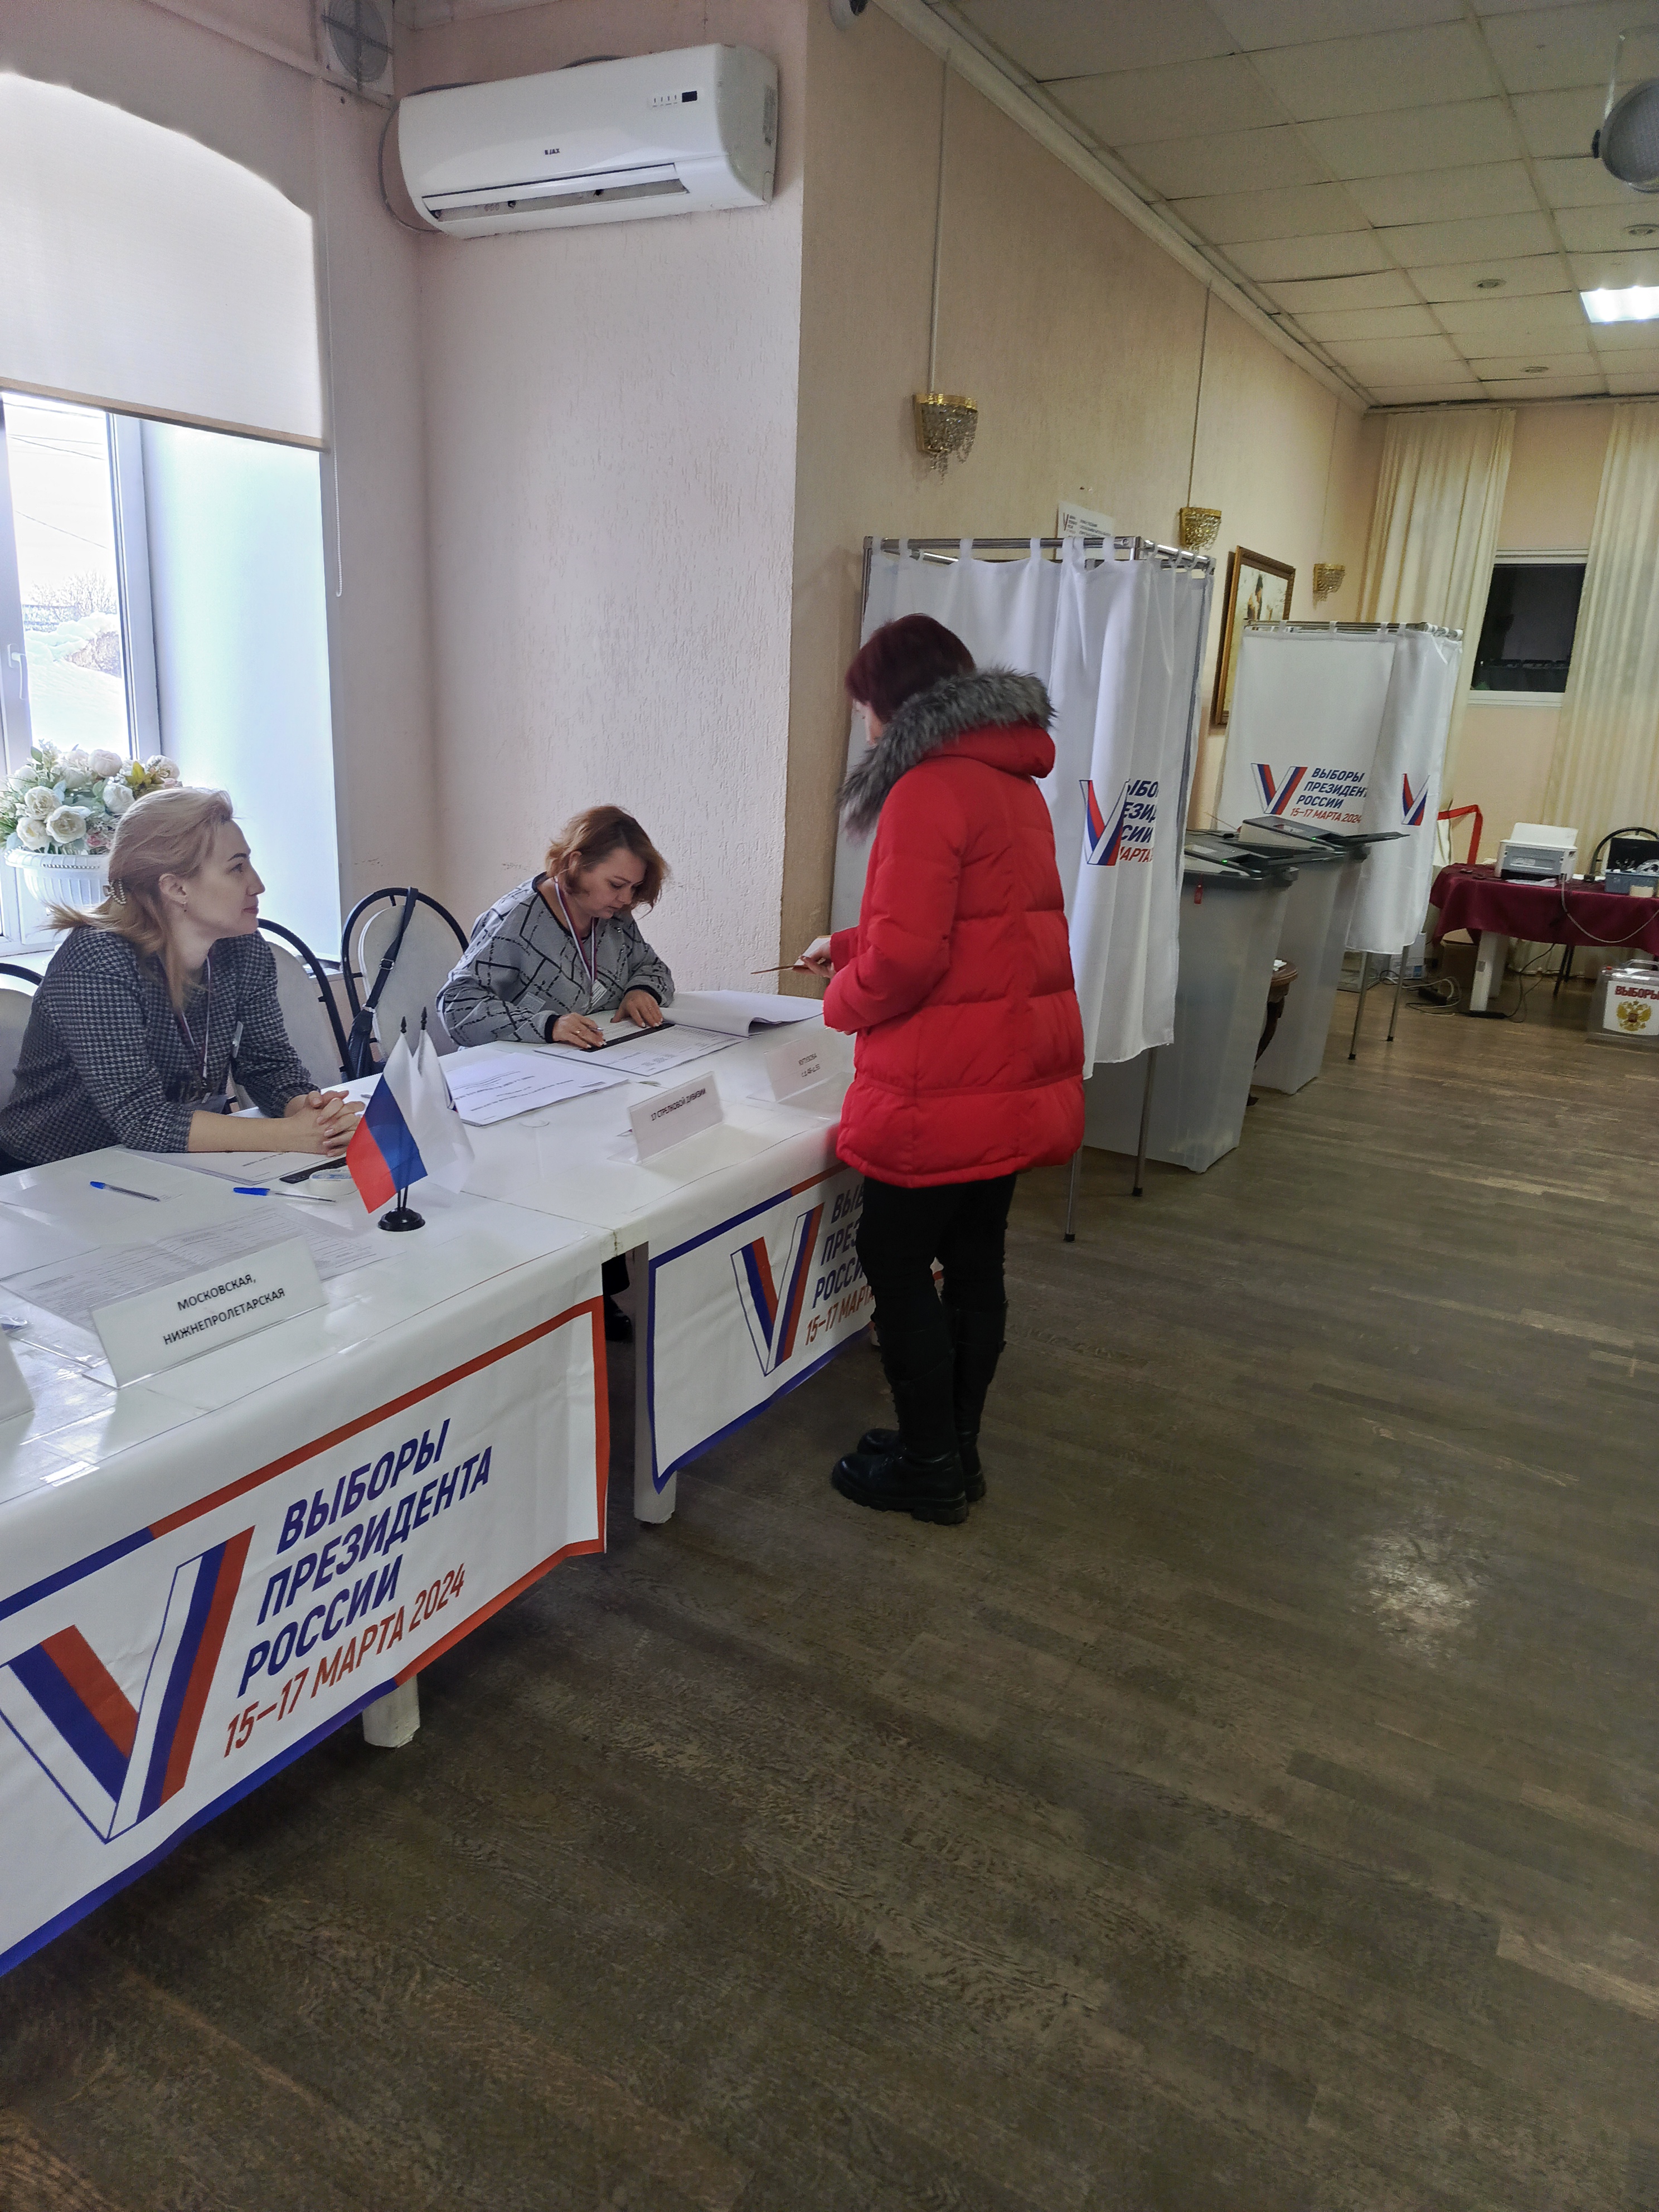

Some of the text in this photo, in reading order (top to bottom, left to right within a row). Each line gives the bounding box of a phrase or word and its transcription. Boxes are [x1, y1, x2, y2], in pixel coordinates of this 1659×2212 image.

[1296, 794, 1344, 809] РОССИИ
[1303, 781, 1368, 798] ПРЕЗИДЕНТ
[1311, 768, 1365, 783] ВЫБОРЫ
[1312, 810, 1342, 821] МАРТА
[1341, 813, 1362, 823] 2024
[177, 1274, 256, 1311] МОСКОВСКАЯ,
[812, 1255, 863, 1309] РОССИ
[163, 1288, 285, 1345] НИЖНЕПРОЛЕТАРСКАЯ
[276, 1418, 451, 1555] ВЫБОРЫ
[257, 1445, 492, 1626] ПРЕЗИДЕНТА
[237, 1554, 403, 1698] РОССИИ
[311, 1607, 404, 1699] МАРТА
[409, 1563, 466, 1633] 2024
